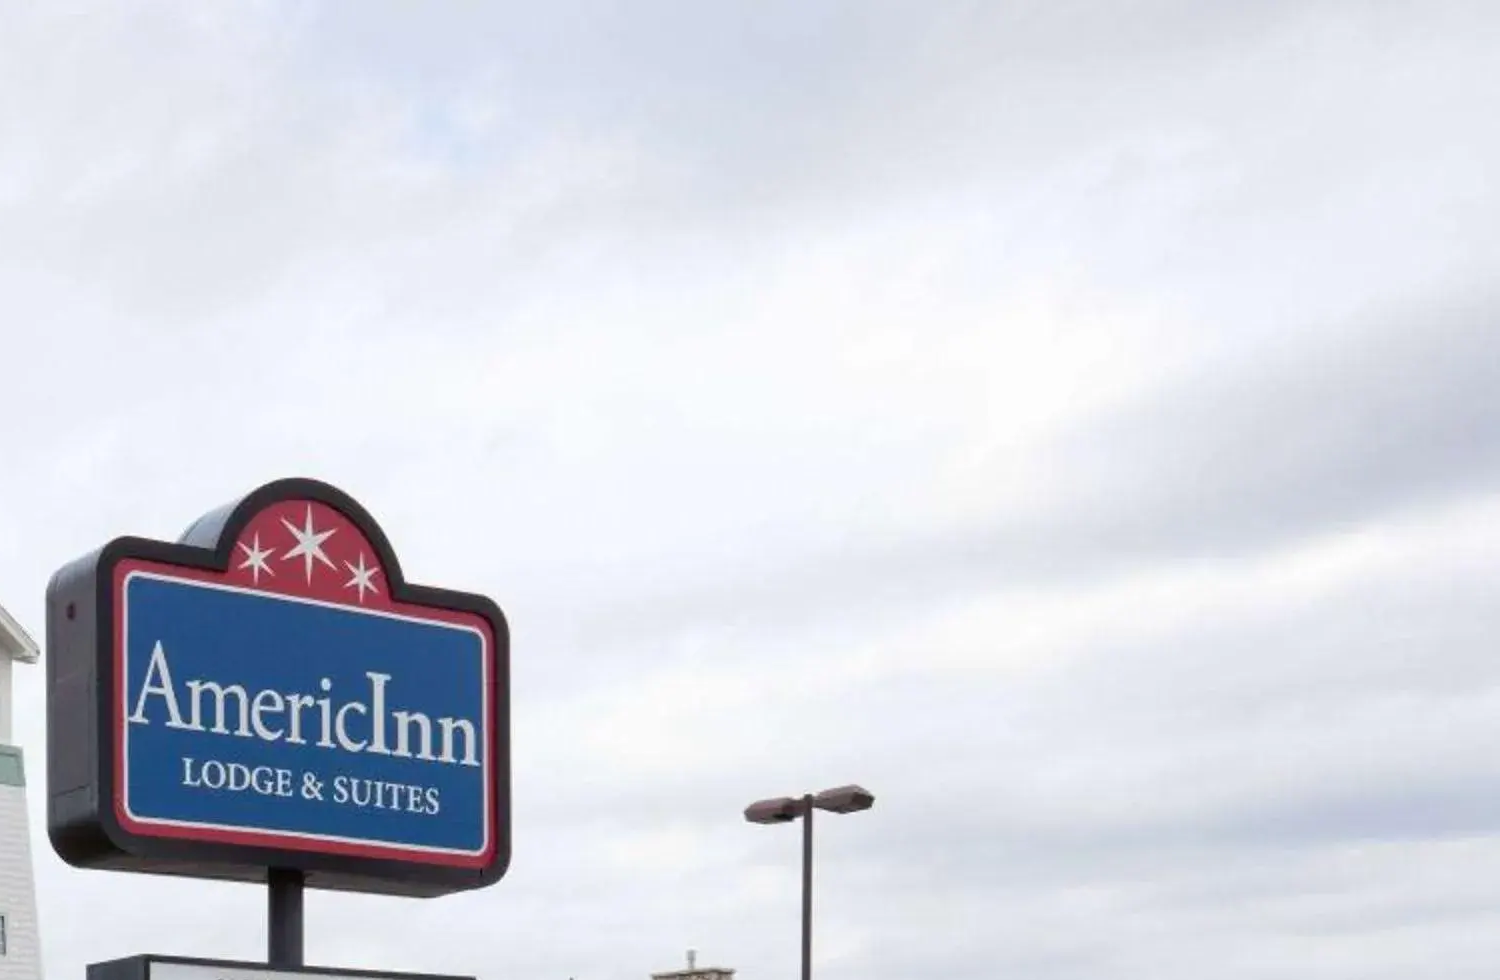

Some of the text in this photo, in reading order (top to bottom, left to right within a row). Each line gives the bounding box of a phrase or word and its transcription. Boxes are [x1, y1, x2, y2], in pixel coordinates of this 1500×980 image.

[128, 640, 480, 766] AmericInn
[181, 757, 440, 815] LODGE & SUITES
